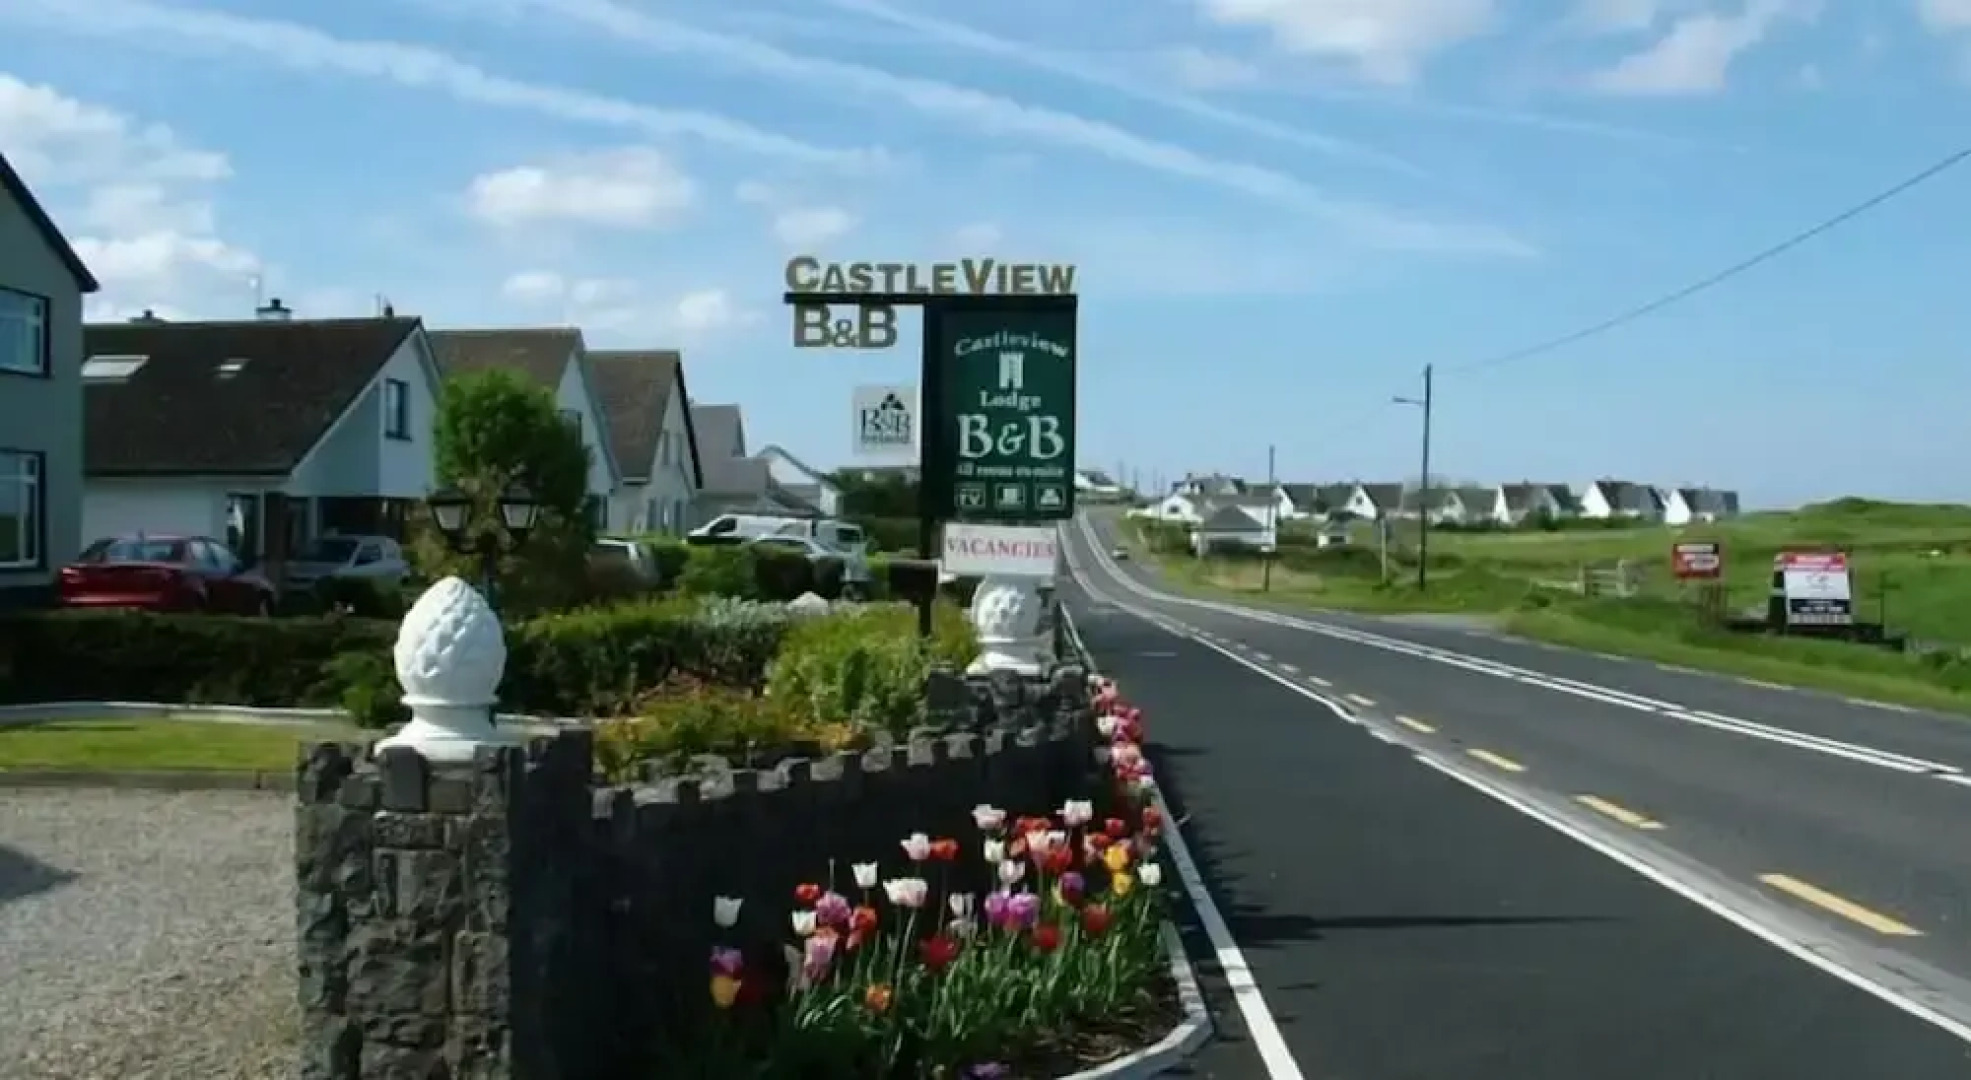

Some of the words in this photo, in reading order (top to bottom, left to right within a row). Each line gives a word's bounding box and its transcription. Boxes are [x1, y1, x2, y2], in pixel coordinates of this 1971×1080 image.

[794, 302, 897, 347] B&B
[957, 414, 1064, 459] B&B
[960, 488, 983, 506] TV
[946, 537, 1056, 558] VACANCIES
